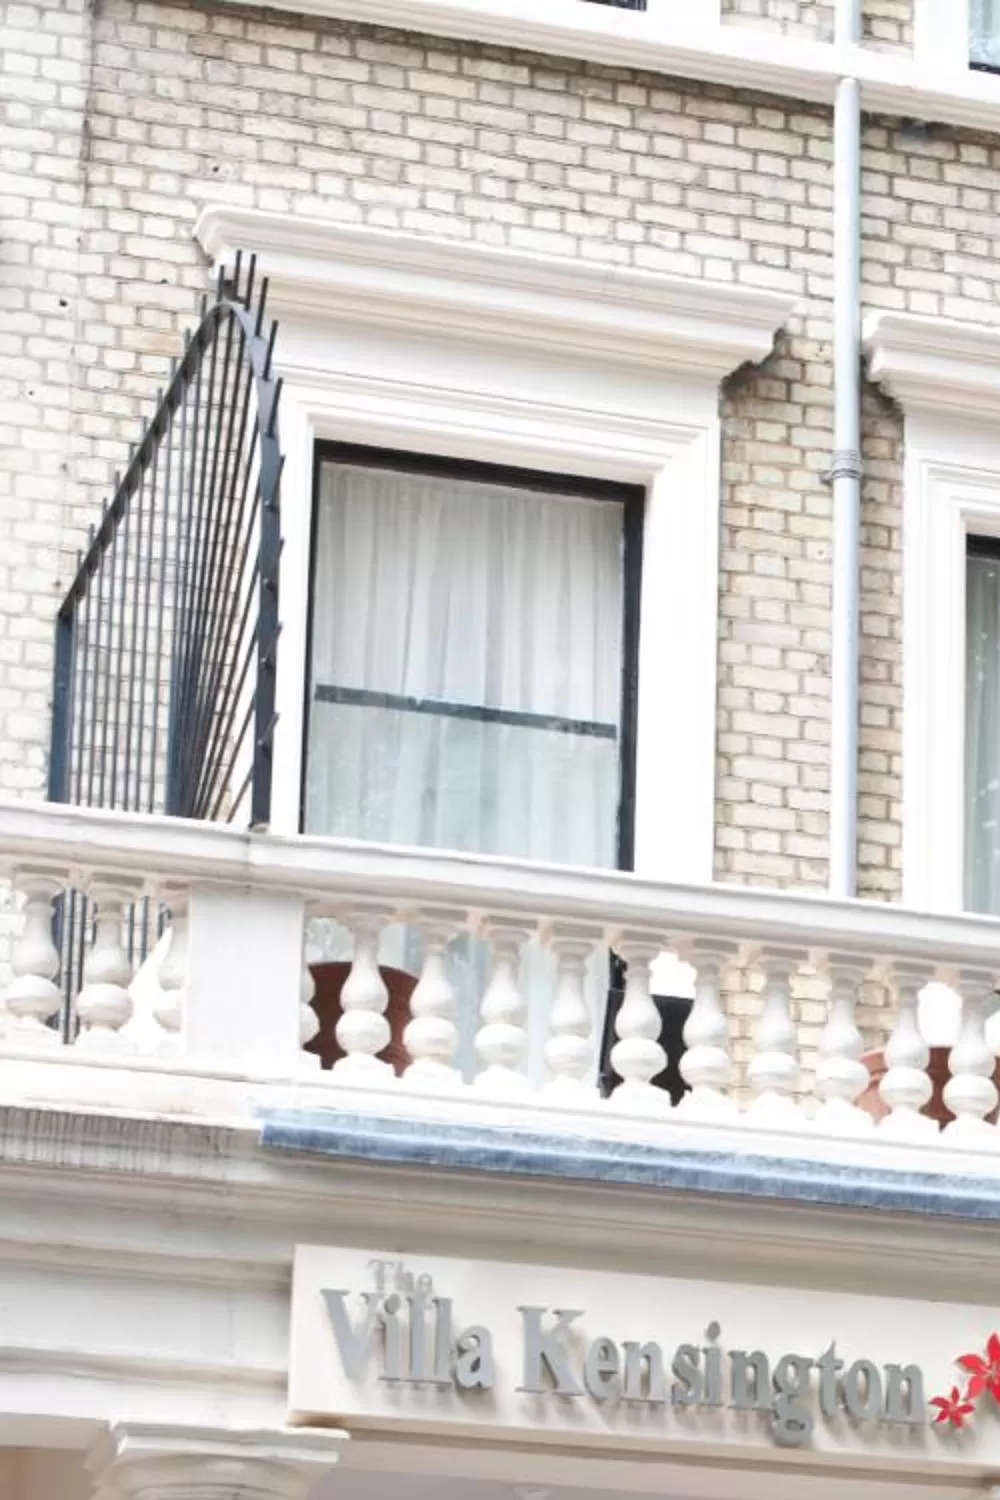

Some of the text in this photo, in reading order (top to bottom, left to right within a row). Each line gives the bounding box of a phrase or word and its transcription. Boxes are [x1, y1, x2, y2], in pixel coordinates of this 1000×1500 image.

[367, 1259, 433, 1296] The
[320, 1288, 927, 1446] Villa Kensington
